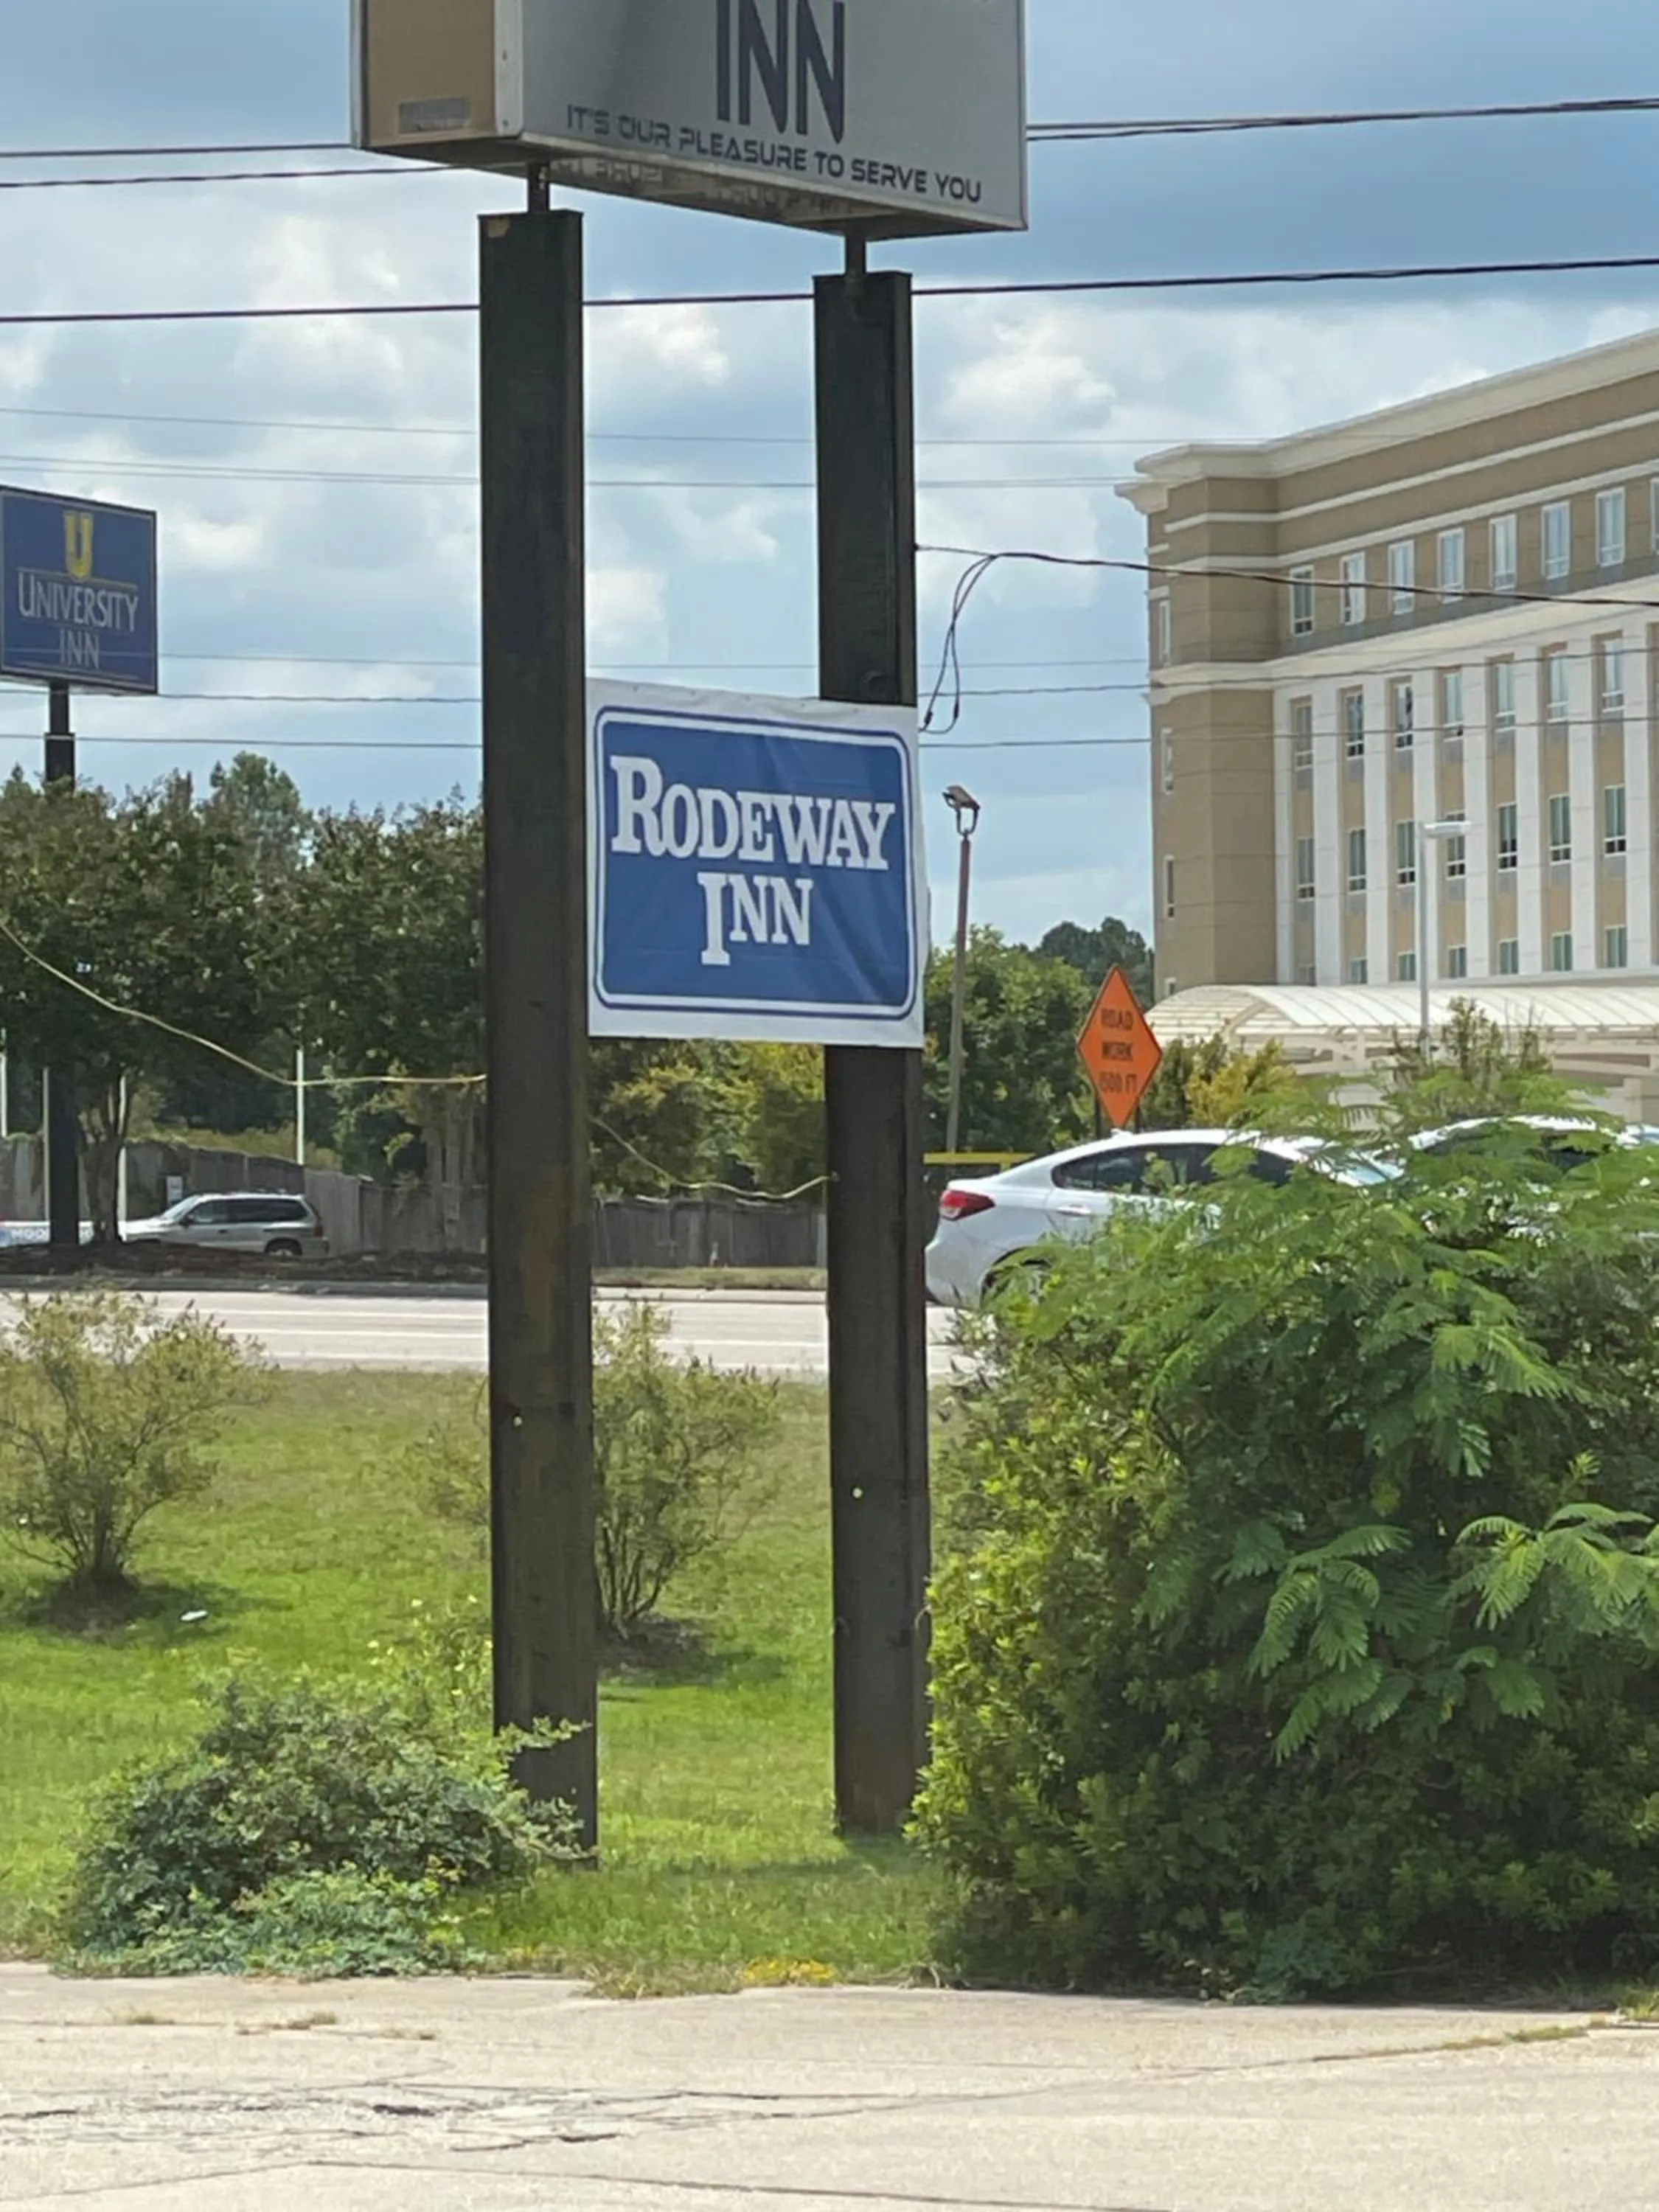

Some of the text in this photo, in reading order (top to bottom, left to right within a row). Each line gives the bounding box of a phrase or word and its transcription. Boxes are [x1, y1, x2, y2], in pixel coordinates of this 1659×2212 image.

[716, 0, 846, 144] INN
[616, 114, 671, 148] OUR
[678, 126, 807, 171] PLEASURE
[813, 150, 845, 178] TO
[850, 157, 928, 194] SERVE
[933, 171, 982, 204] YOU
[18, 572, 139, 633] UNIVERSITY
[60, 628, 100, 669] INN
[610, 754, 896, 871] RODEWAY
[697, 872, 814, 967] INN
[1101, 1008, 1133, 1031] ROAD
[1102, 1040, 1133, 1062] WORK
